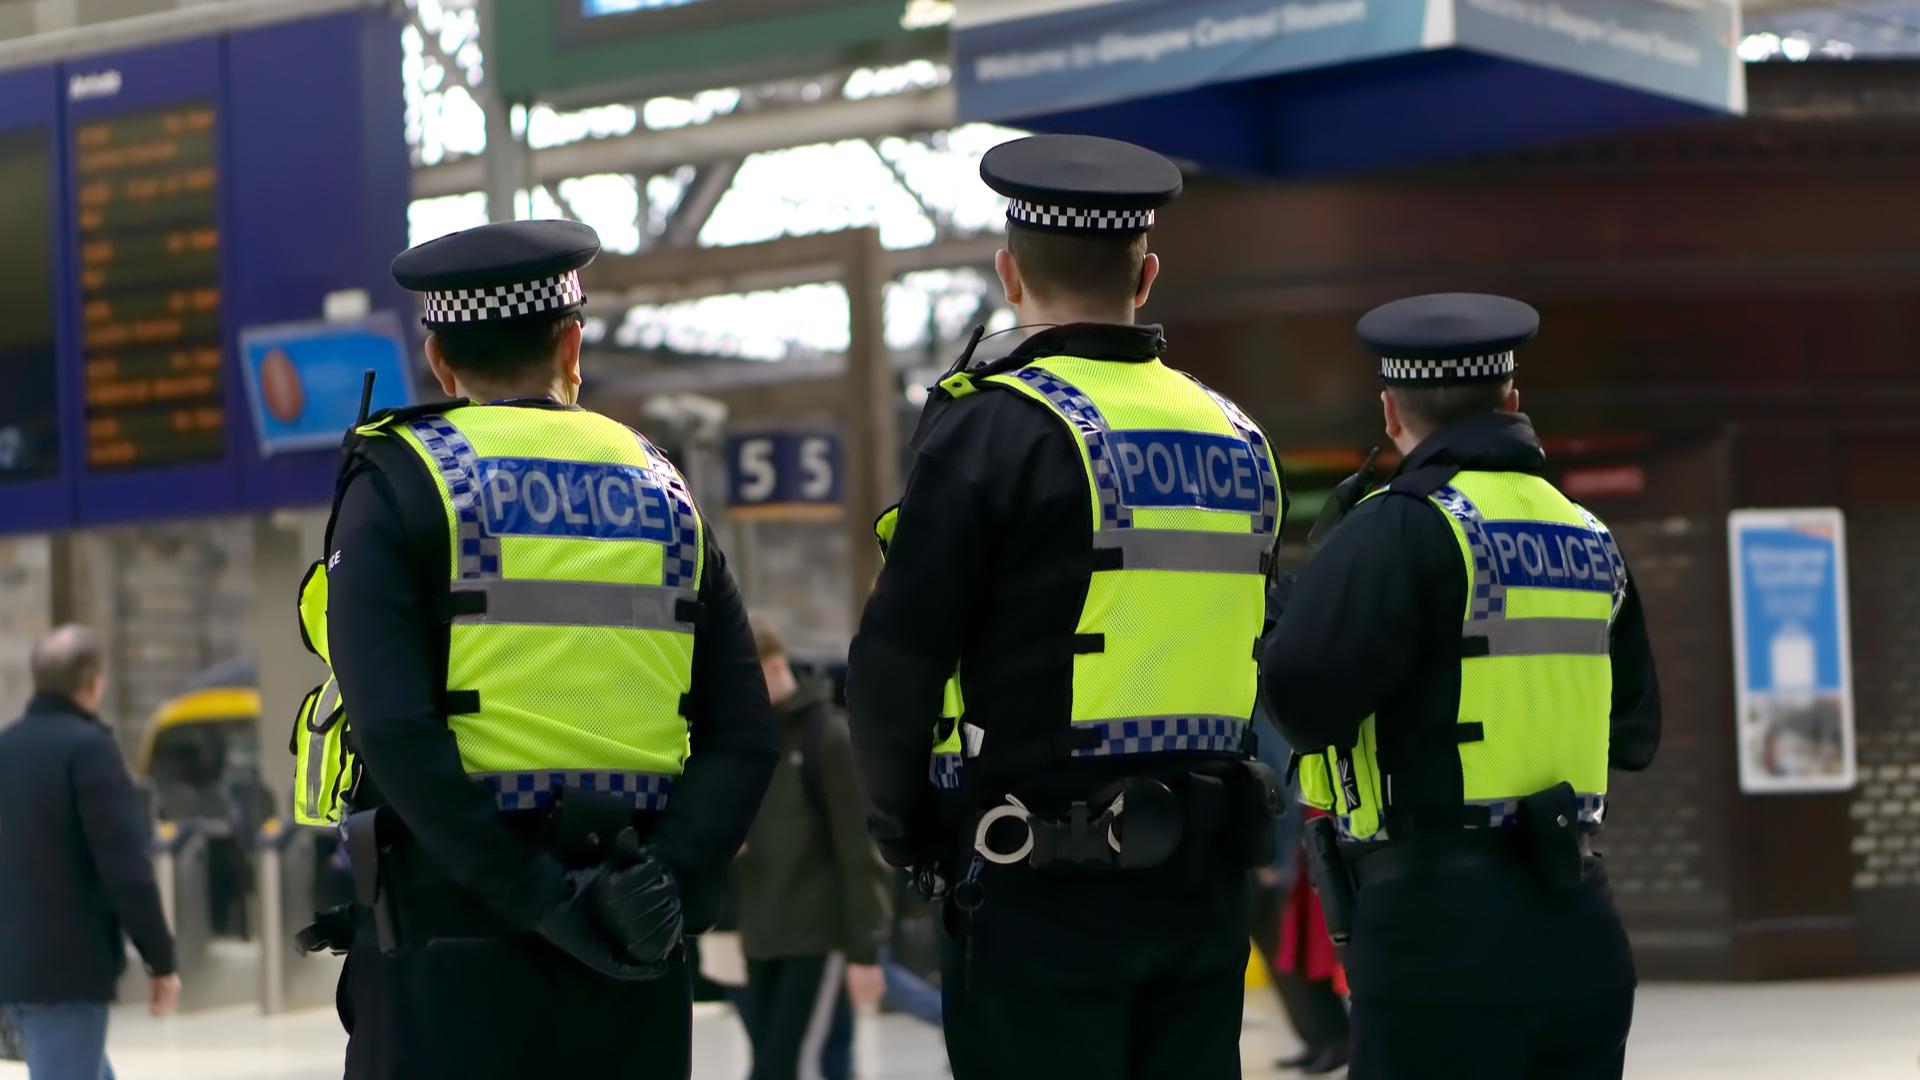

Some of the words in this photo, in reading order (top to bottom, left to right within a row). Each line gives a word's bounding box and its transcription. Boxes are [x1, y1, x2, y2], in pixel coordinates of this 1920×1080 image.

[1098, 29, 1189, 62] Glasgow
[1194, 7, 1276, 46] Central
[1281, 1, 1364, 31] Station
[487, 469, 665, 529] POLICE
[740, 444, 777, 501] 5
[800, 443, 833, 499] 5
[1116, 442, 1256, 499] POLICE
[1493, 532, 1609, 581] POLICE
